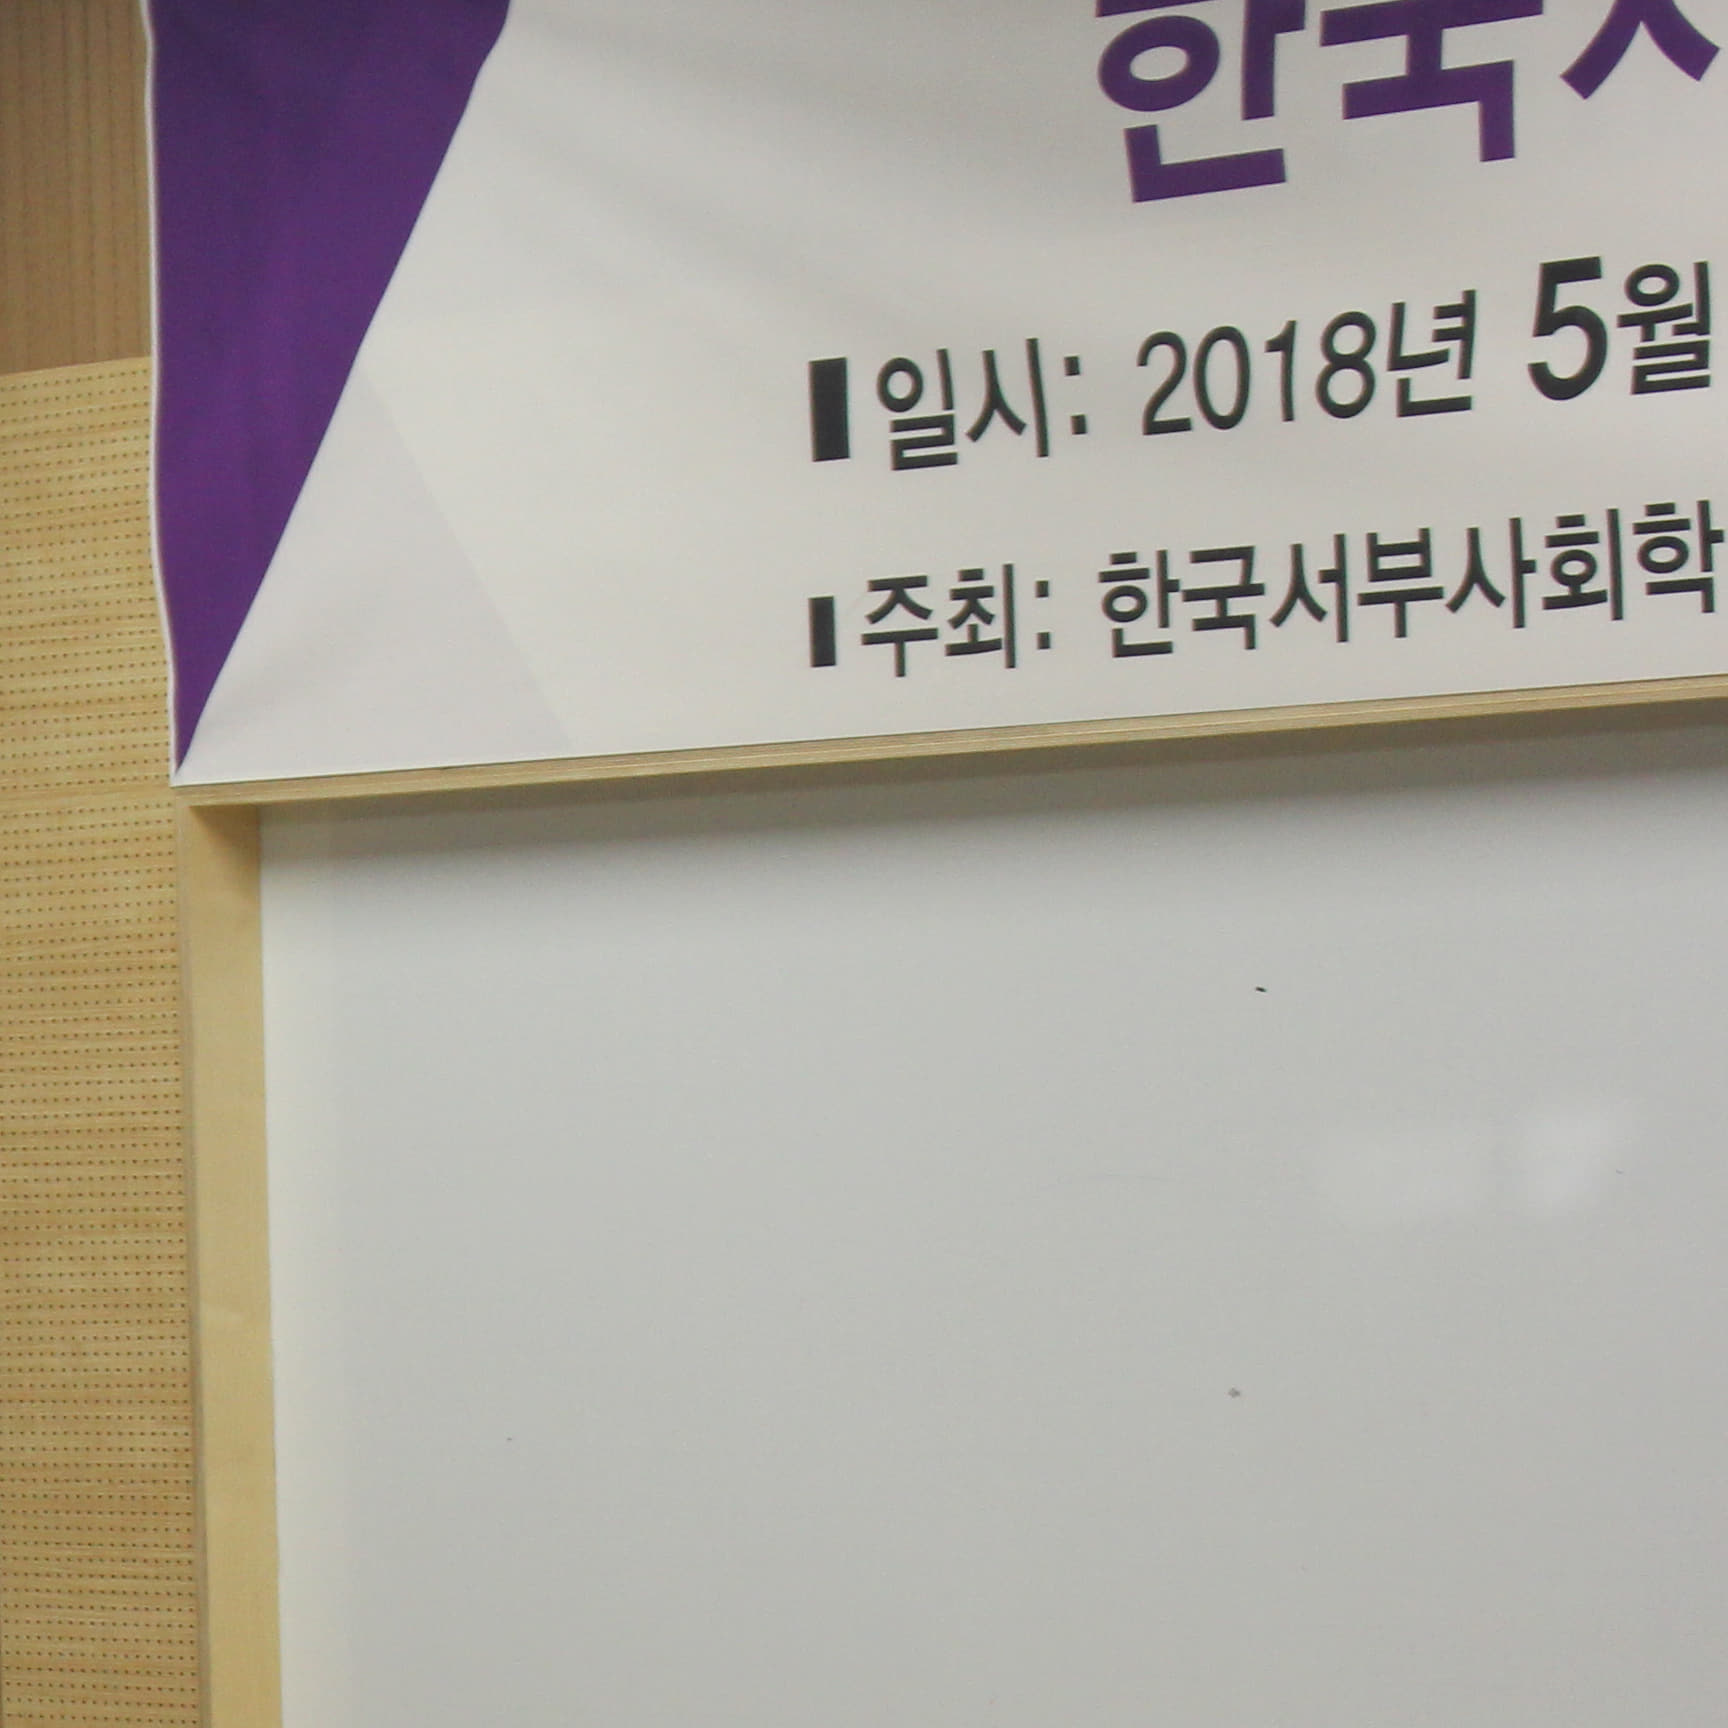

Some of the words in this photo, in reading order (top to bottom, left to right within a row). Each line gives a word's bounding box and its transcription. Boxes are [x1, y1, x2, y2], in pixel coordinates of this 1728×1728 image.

[875, 337, 1089, 472] 일시:
[1136, 289, 1478, 436] 2018년
[1527, 255, 1712, 402] 5월
[860, 563, 1053, 679] 주최:
[1097, 499, 1726, 660] 한국서부사회학
